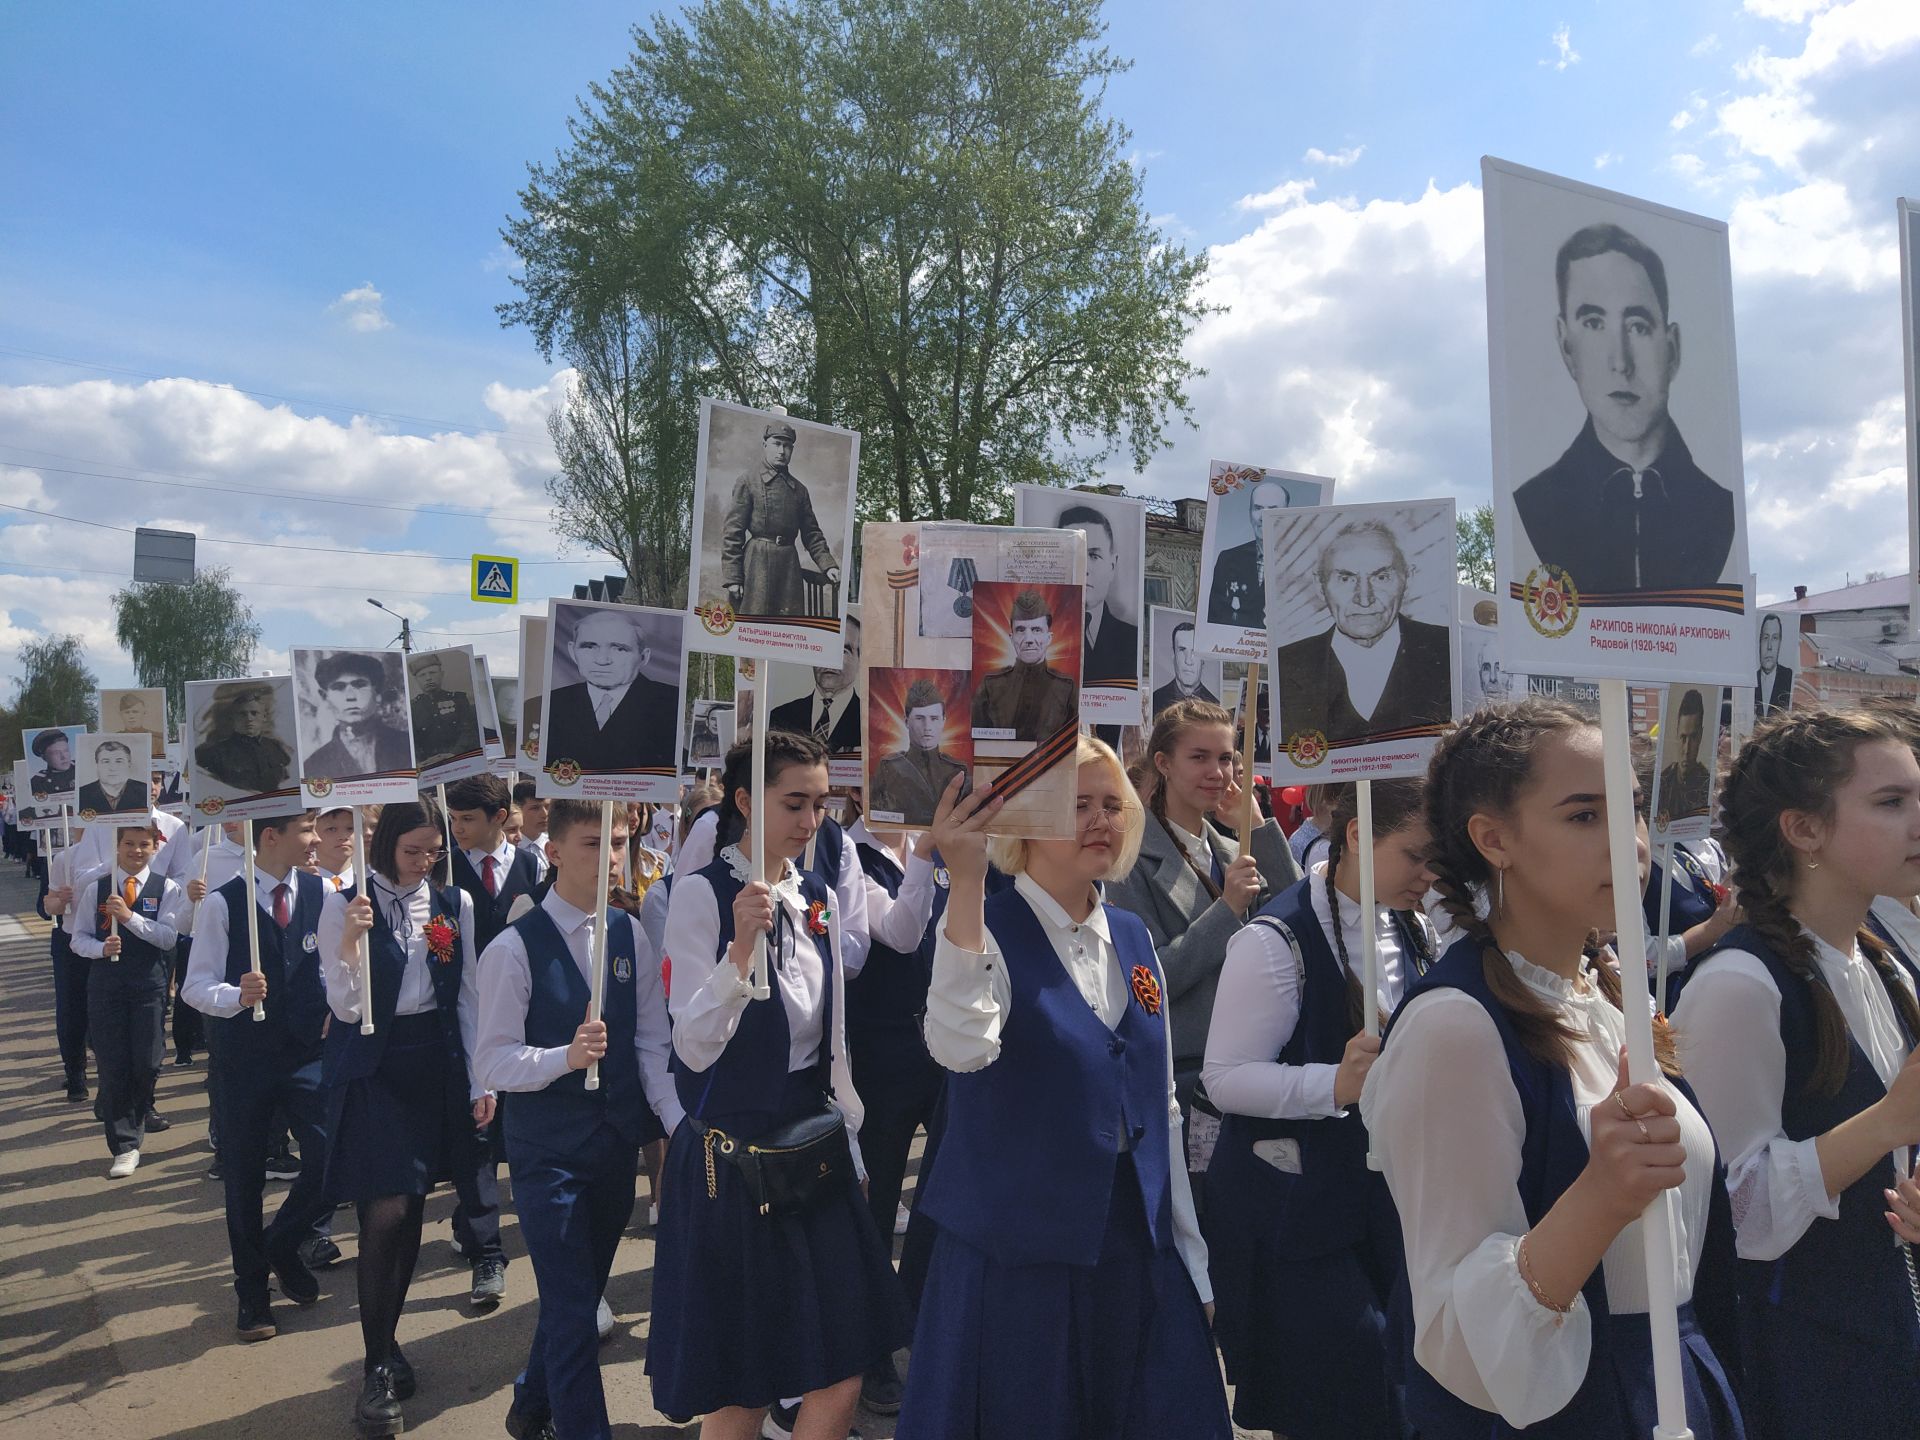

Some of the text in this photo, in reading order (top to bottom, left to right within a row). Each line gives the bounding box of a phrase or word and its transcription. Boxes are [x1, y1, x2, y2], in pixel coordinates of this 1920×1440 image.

[738, 626, 772, 637] БАТЫРШИН
[1590, 618, 1731, 640] АРХИПОВ НИКОЛАЙ АРХИПОВИЧ
[738, 635, 765, 645] Командир
[766, 639, 793, 648] отделения
[1590, 636, 1677, 655] Рядовой (1920-1942)
[1211, 644, 1261, 659] Александр
[1331, 752, 1419, 766] НИКИТИН ИВАН ЕФИМОВИЧ
[1331, 766, 1357, 774] рядовой
